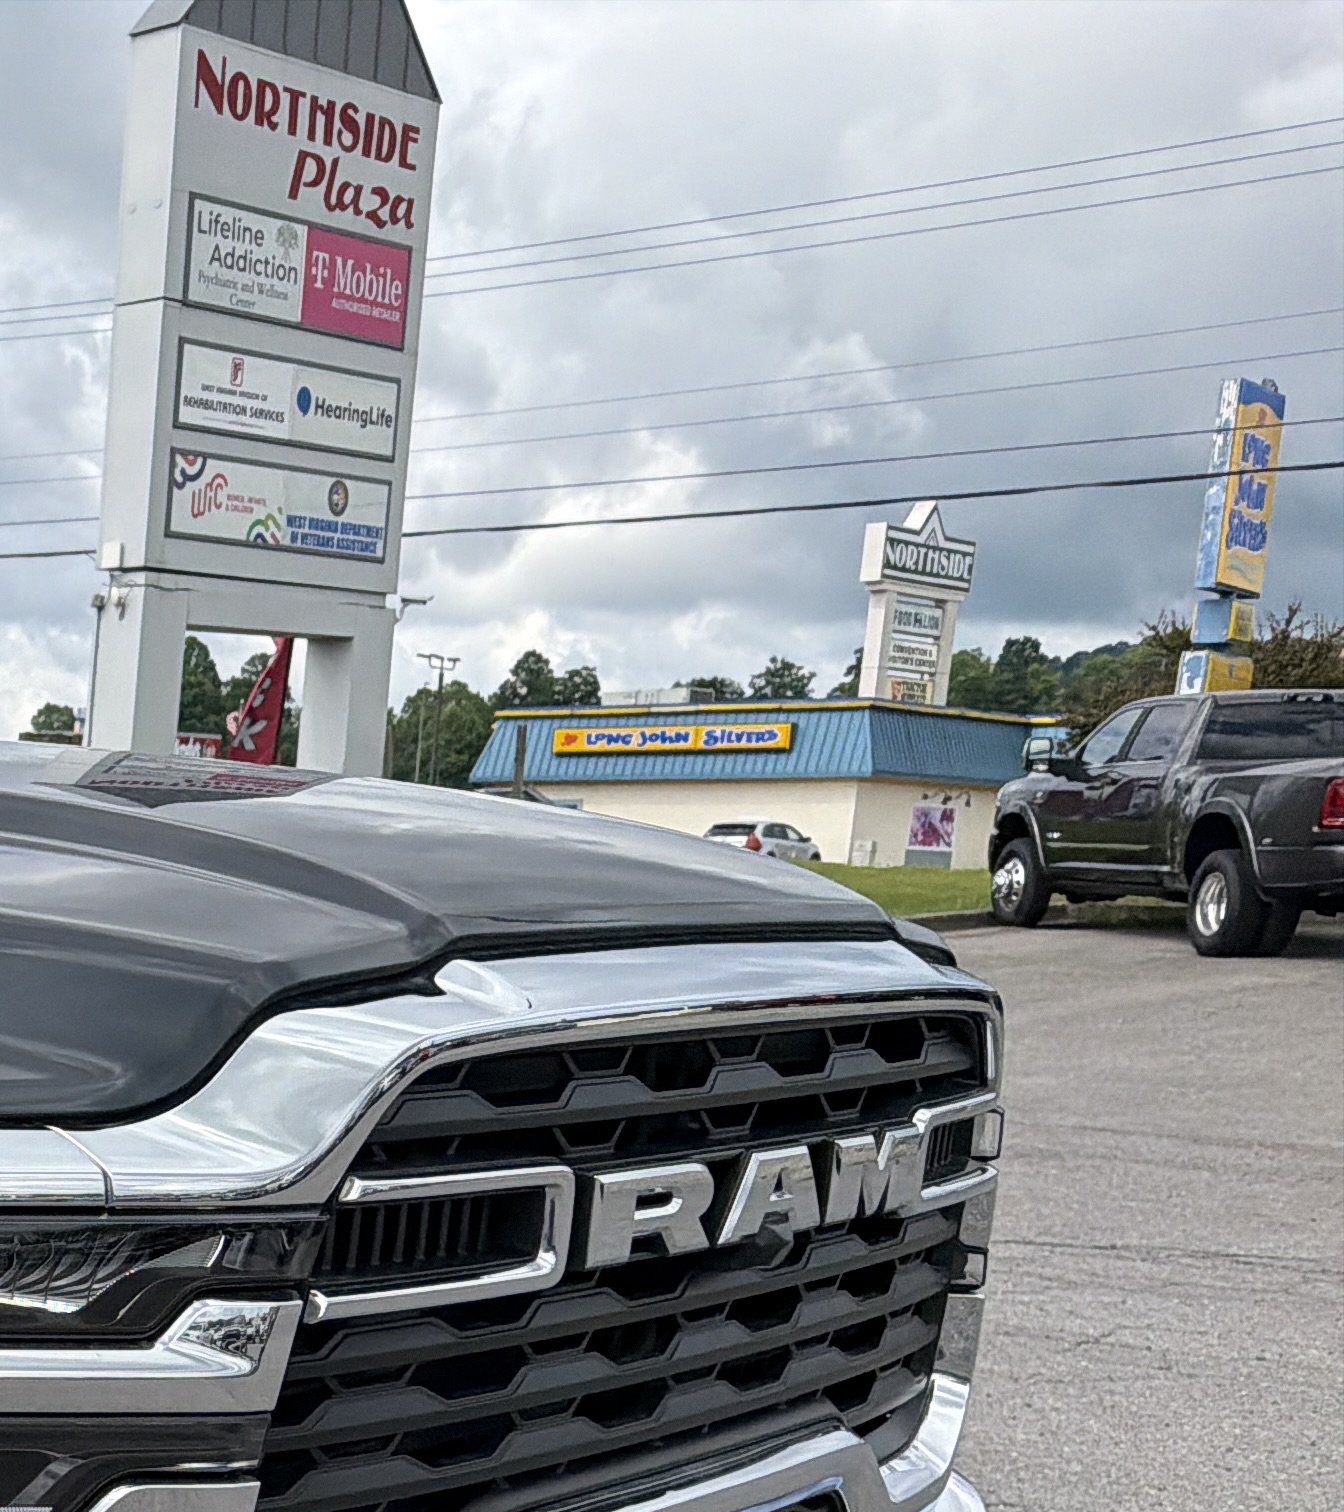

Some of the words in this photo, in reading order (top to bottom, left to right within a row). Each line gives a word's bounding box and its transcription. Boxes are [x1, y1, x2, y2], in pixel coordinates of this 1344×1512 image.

[194, 48, 420, 171] NORTHSIDE
[287, 149, 415, 230] Plaza
[197, 210, 265, 247] Lifeline
[209, 244, 298, 285] Addiction
[333, 256, 402, 306] Mobile
[314, 396, 393, 429] HearingLife
[286, 514, 307, 530] WEST
[884, 541, 973, 579] NORTHSIDE
[586, 732, 633, 746] LONG
[584, 1127, 926, 1270] RAM
